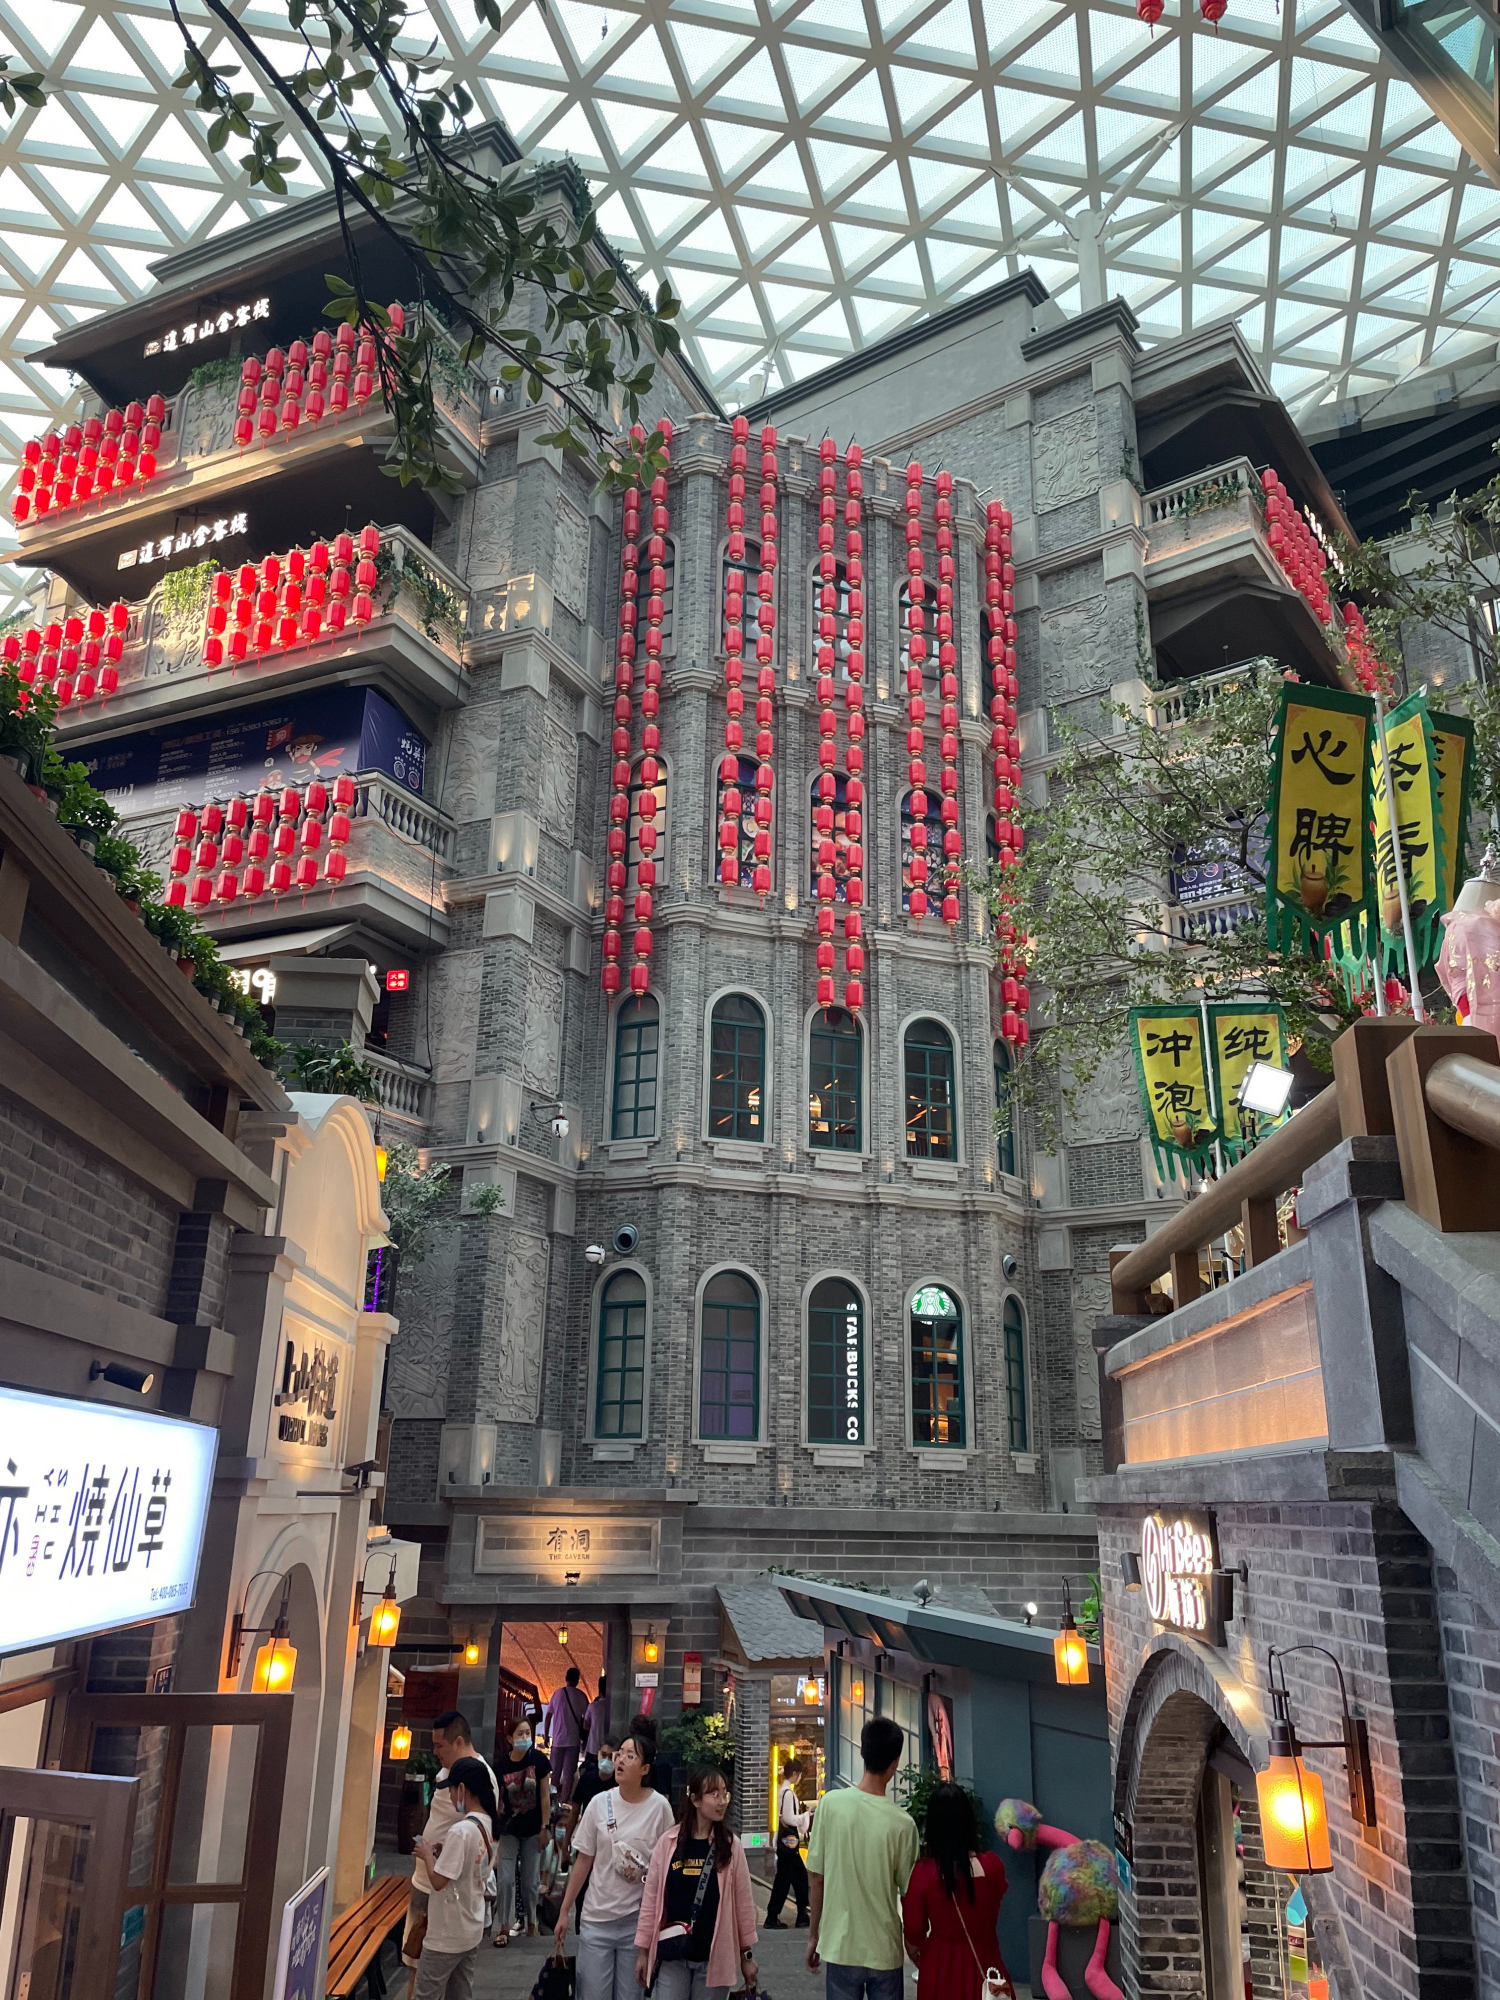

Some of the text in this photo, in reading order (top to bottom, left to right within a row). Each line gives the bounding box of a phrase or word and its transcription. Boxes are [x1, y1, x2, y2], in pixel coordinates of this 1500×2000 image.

[1290, 729, 1356, 867] 心脾
[1376, 742, 1430, 886] 茶香
[1146, 1029, 1202, 1117] 冲泡
[546, 1527, 590, 1552] 有洞
